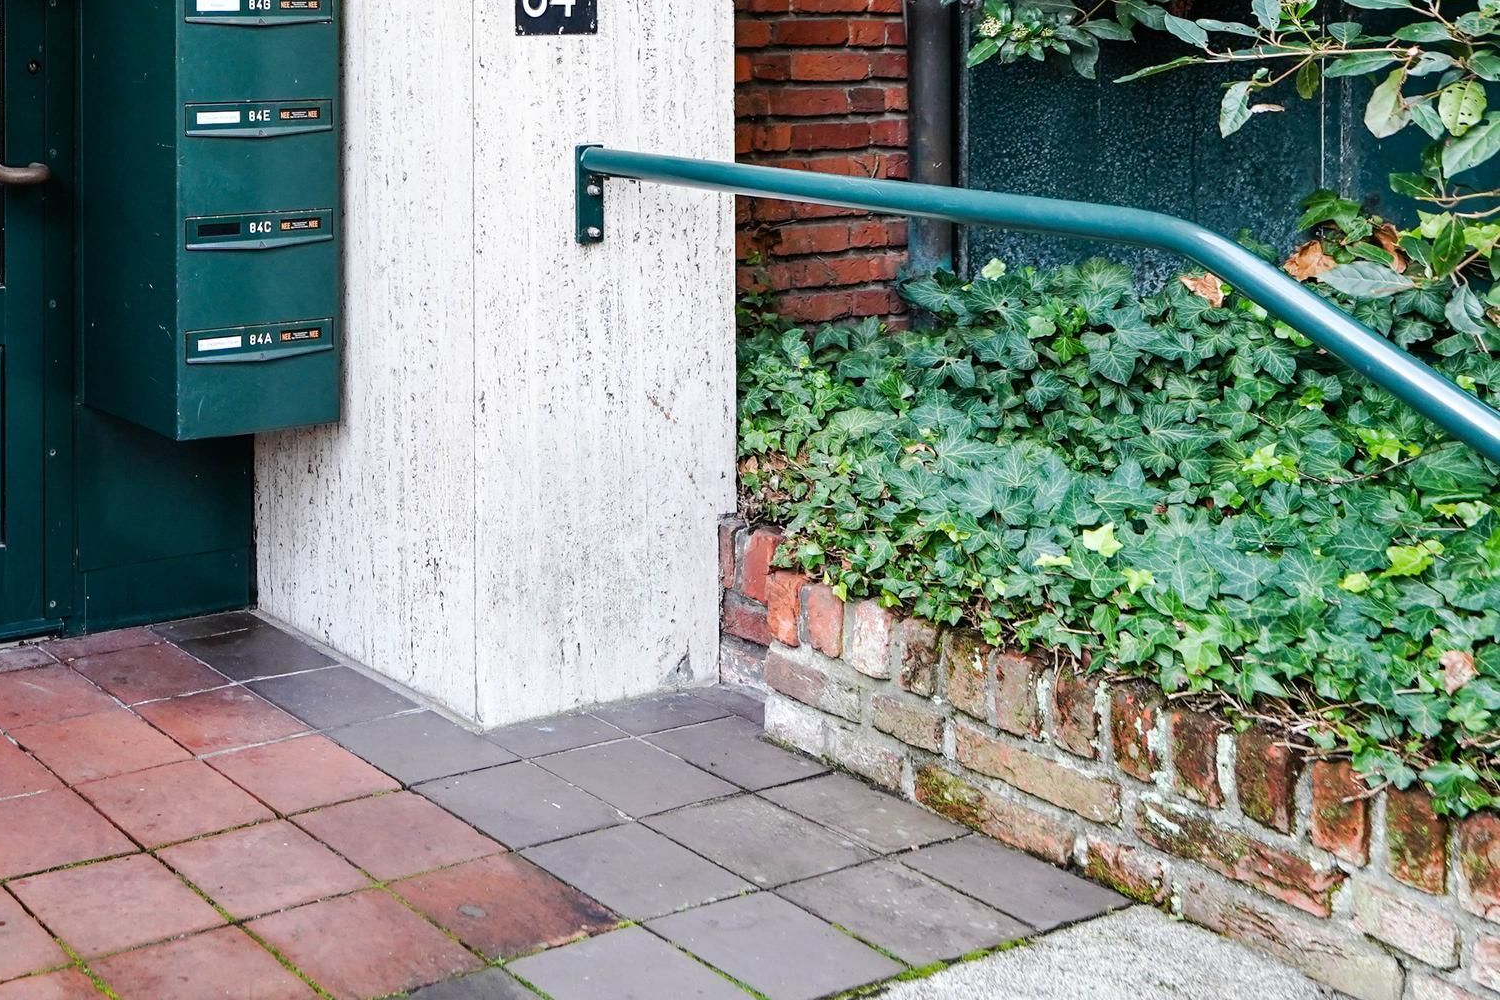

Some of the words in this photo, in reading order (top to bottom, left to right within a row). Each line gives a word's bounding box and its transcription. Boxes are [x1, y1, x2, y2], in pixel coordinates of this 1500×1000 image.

[280, 1, 290, 9] NEE
[308, 1, 318, 9] NEE
[248, 110, 271, 122] 84E
[280, 111, 290, 119] NEE
[308, 110, 318, 118] NEE
[249, 221, 272, 233] 84C
[281, 222, 291, 230] NEE
[308, 220, 319, 228] NEE
[249, 332, 273, 345] 84A
[281, 332, 292, 341] NEE
[309, 330, 319, 338] NEE
